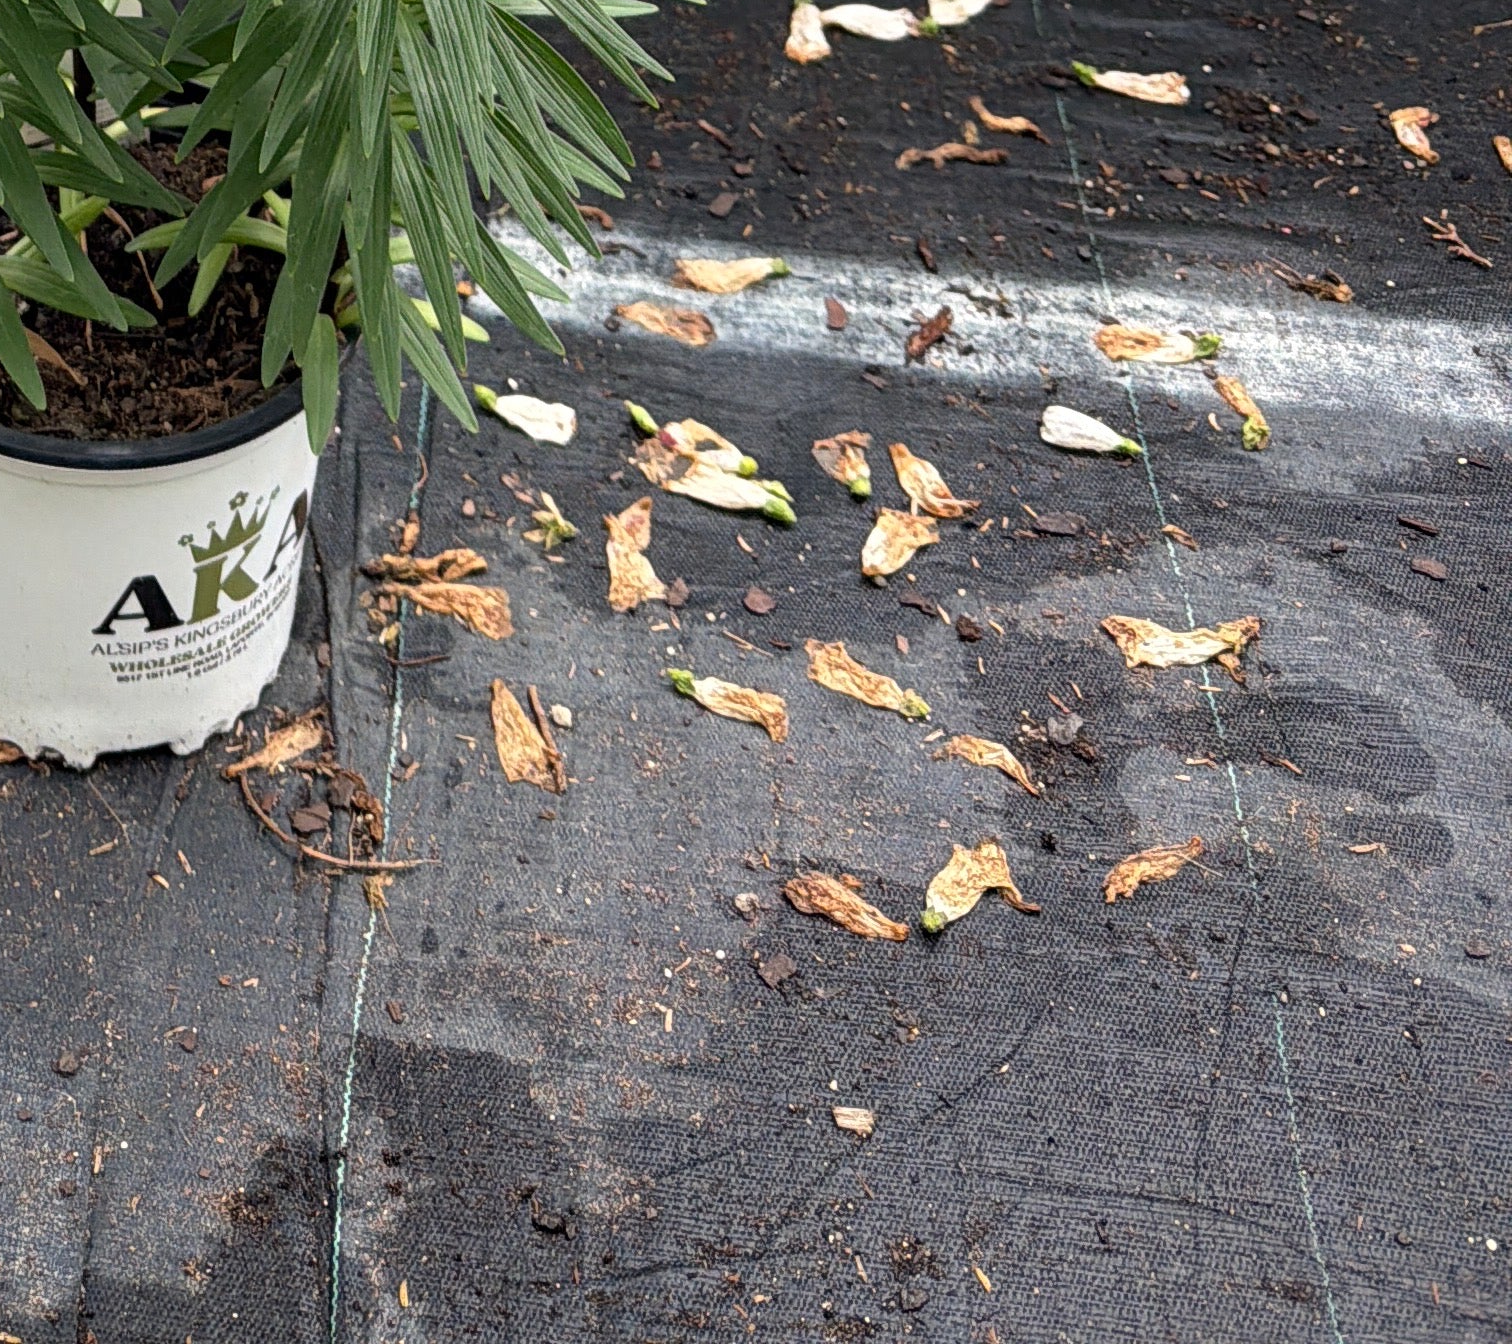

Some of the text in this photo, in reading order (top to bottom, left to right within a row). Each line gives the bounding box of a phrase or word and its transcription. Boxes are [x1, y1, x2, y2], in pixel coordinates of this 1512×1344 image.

[90, 488, 308, 636] AKA
[90, 637, 169, 656] ALSIP'S
[174, 582, 273, 648] KINGSBURY
[109, 634, 227, 673] WHOLESALE
